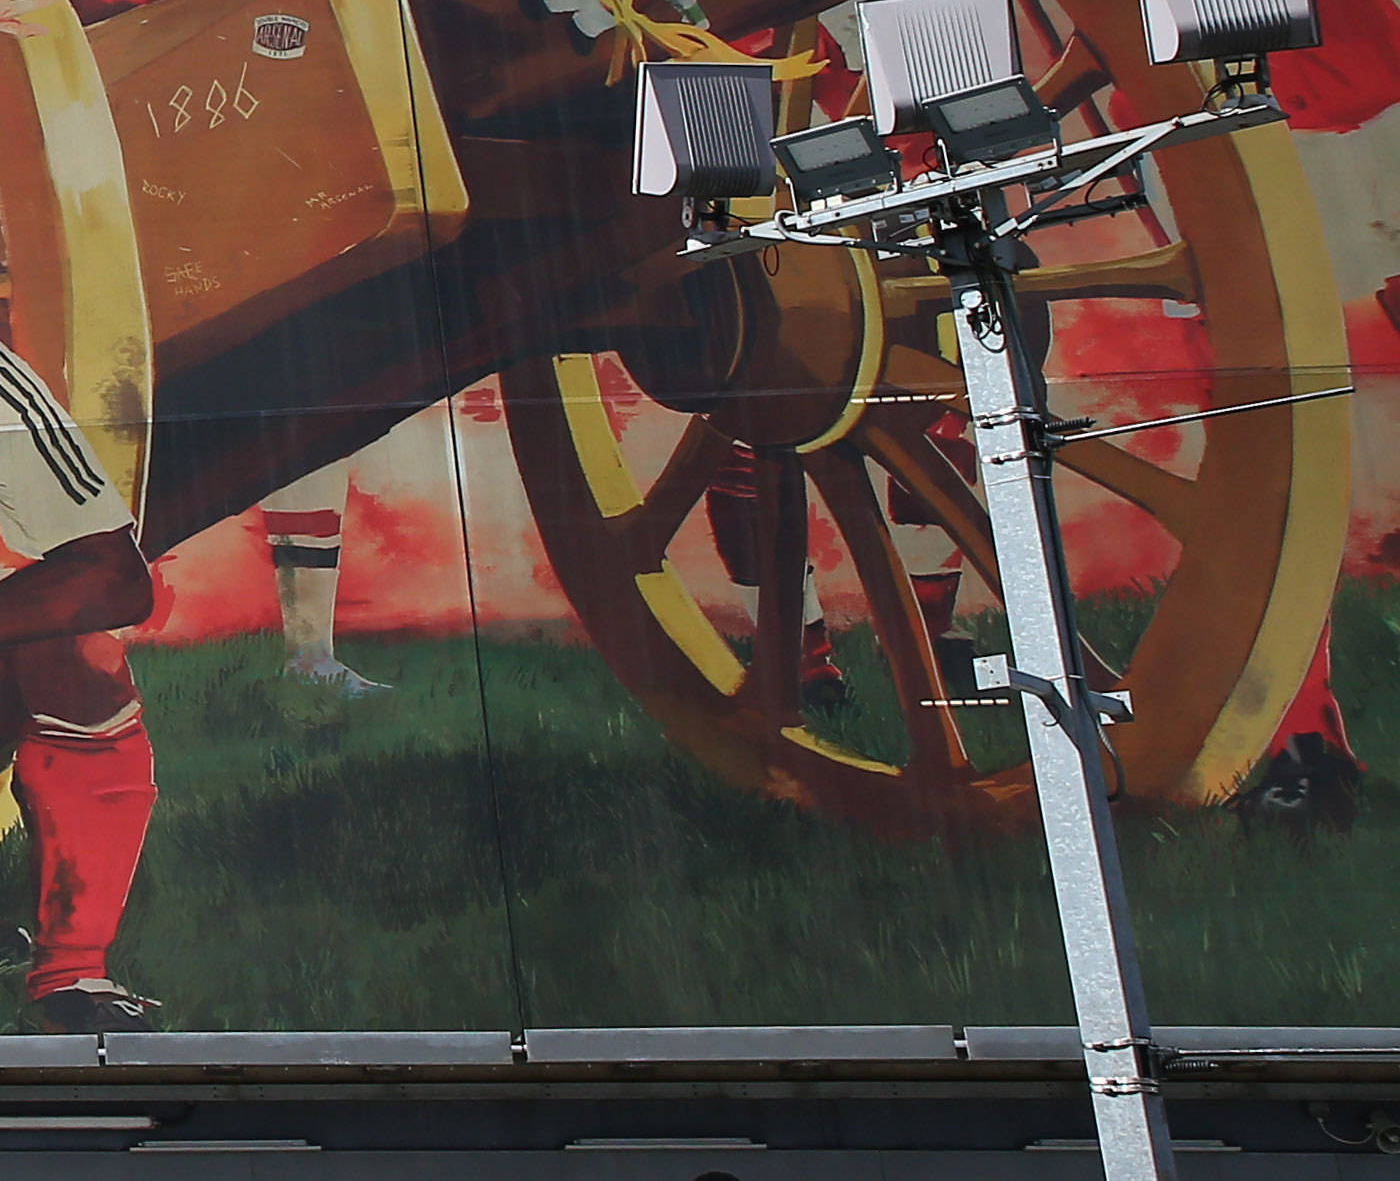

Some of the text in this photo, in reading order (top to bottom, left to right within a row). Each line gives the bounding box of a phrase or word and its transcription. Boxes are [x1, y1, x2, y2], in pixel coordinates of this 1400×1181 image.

[147, 61, 260, 139] 1886
[142, 179, 186, 205] ROCKY
[174, 276, 221, 296] HANDS
